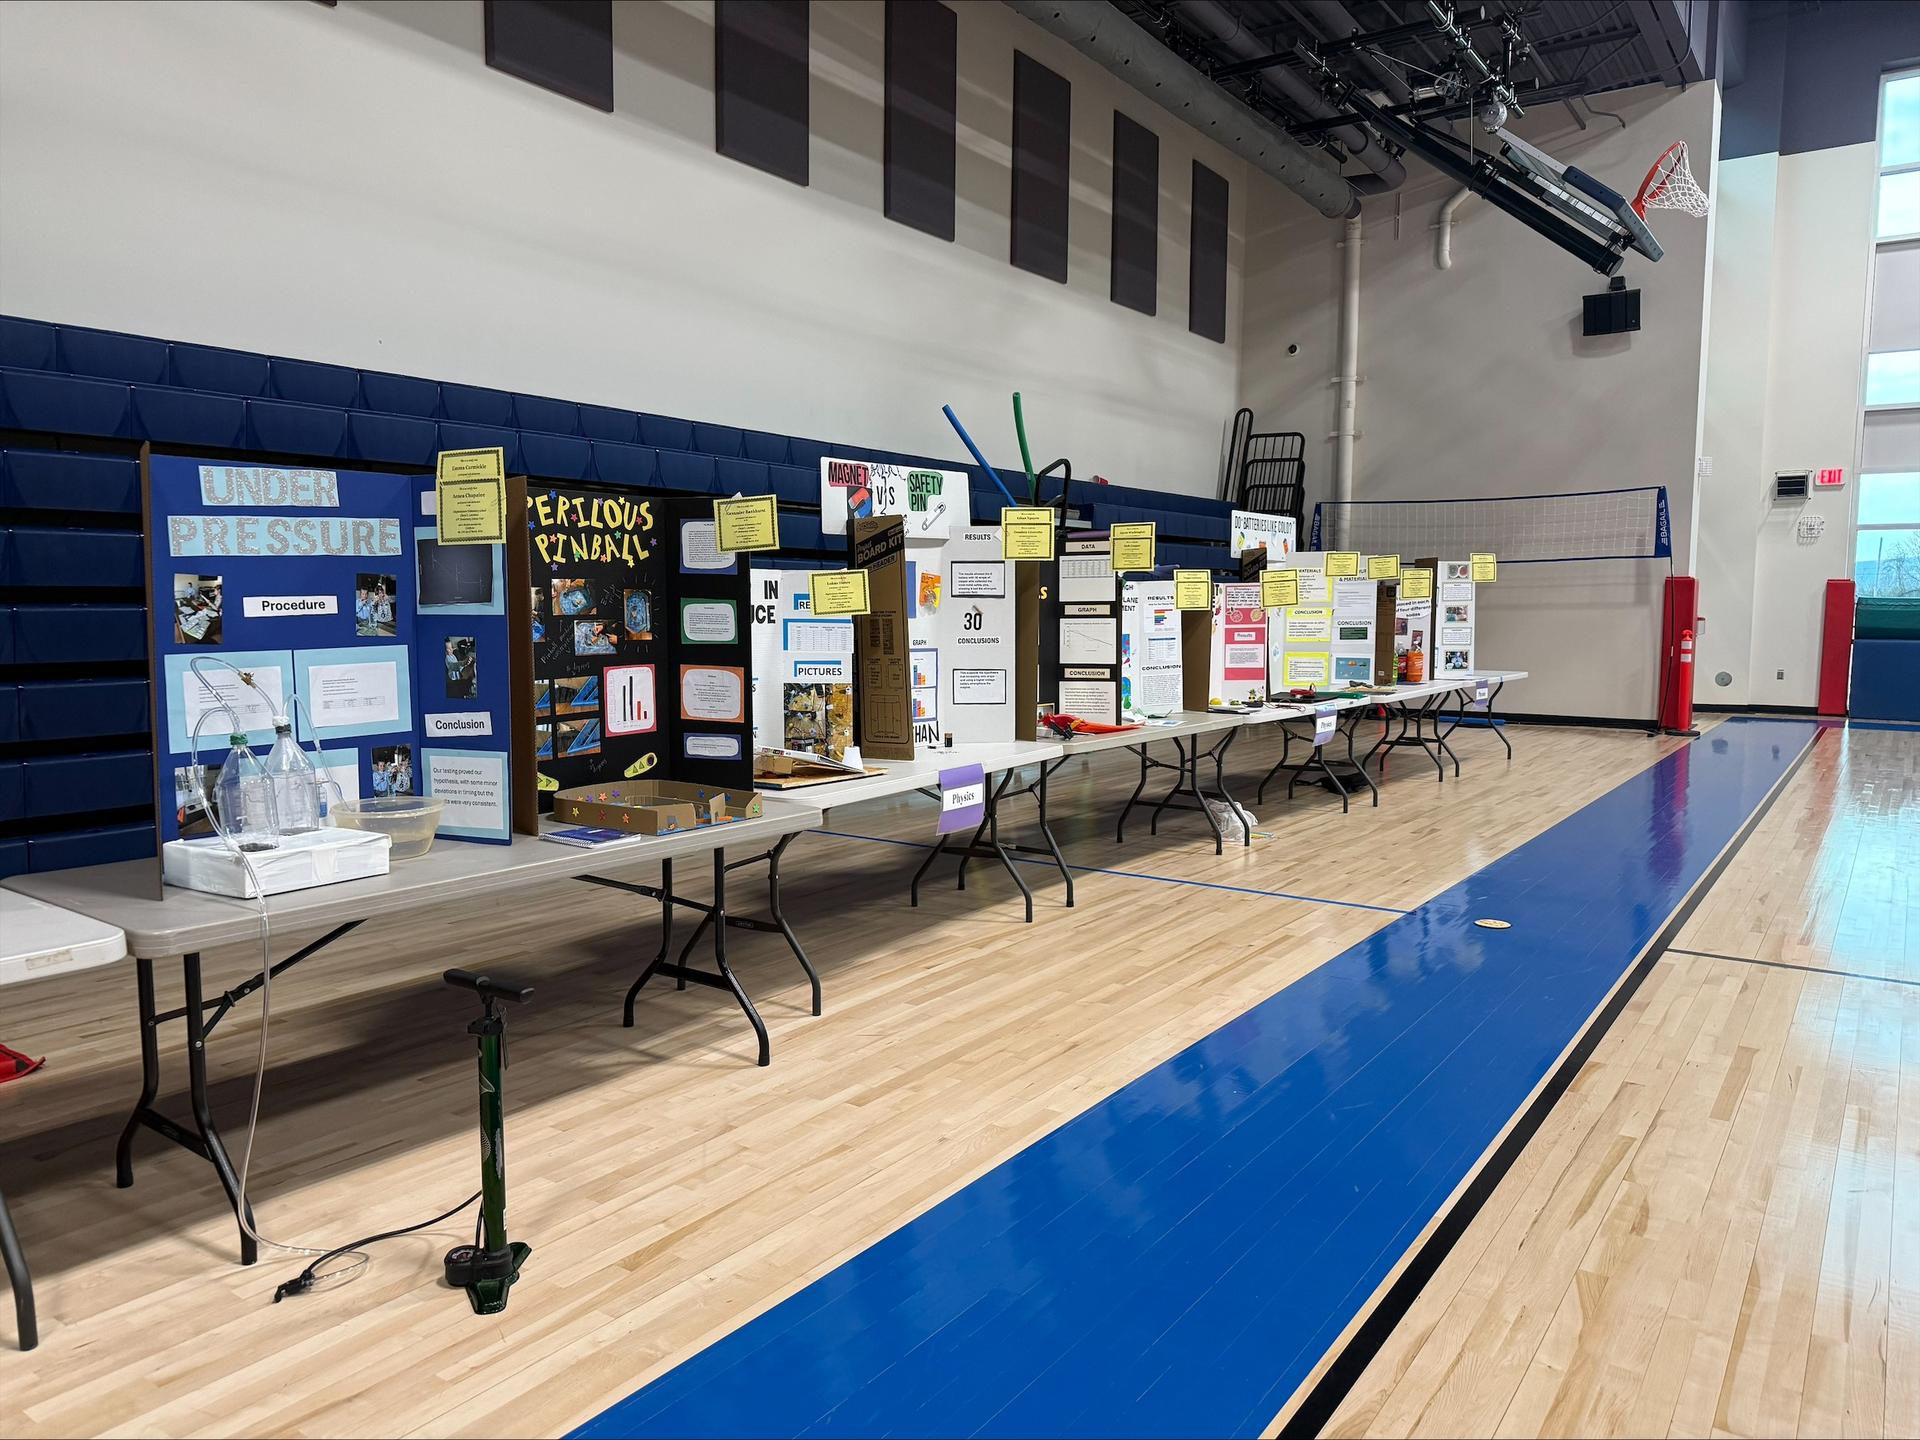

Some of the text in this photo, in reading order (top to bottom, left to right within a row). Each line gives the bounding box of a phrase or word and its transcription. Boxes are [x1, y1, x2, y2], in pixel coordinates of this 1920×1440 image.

[828, 461, 869, 487] MAGNET
[1820, 469, 1842, 484] EXIT
[203, 466, 338, 506] UNDER
[909, 473, 943, 495] SAFETY
[911, 493, 927, 512] PIN
[170, 517, 400, 555] PRESSURE
[964, 533, 991, 541] RESULTS
[535, 533, 650, 564] PINBALL
[857, 532, 903, 564] BOARD KIT
[763, 580, 779, 600] IN
[261, 599, 327, 612] Procedure
[963, 612, 983, 631] 30
[798, 667, 842, 676] PICTURES
[435, 719, 485, 730] Conclusion
[912, 720, 940, 744] HAN
[952, 791, 975, 805] Physics
